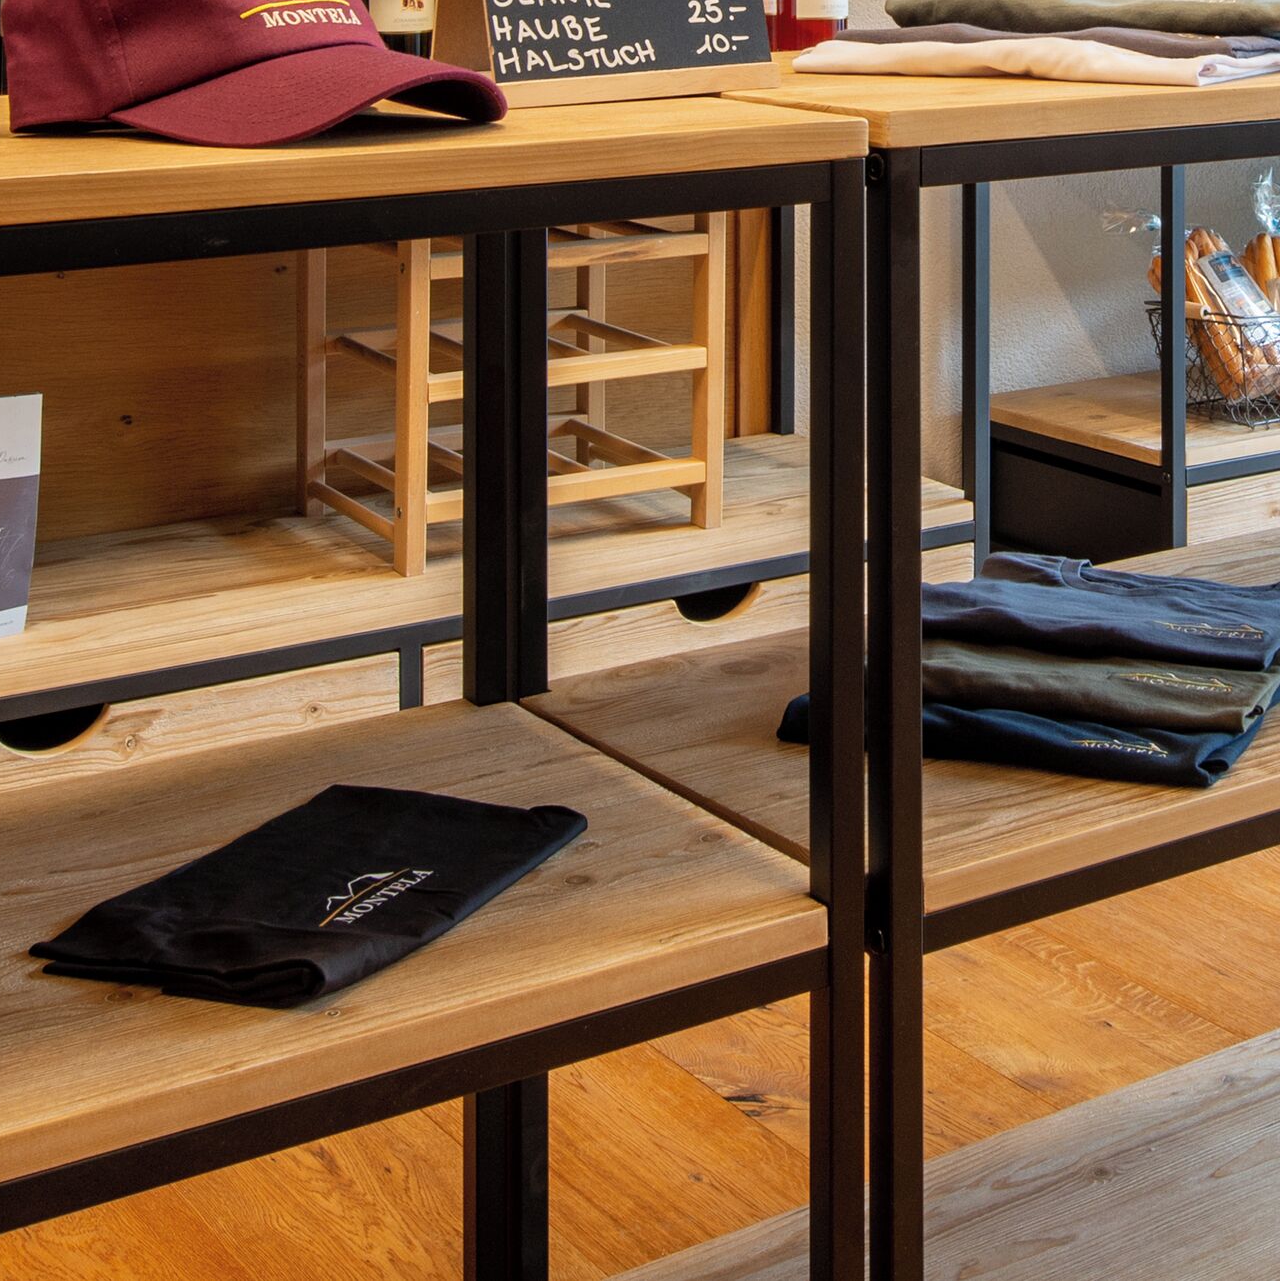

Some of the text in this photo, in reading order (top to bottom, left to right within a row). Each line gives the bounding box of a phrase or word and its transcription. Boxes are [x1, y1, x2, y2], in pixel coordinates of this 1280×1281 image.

[260, 7, 362, 29] MONTELA
[491, 14, 608, 44] HAUBE
[497, 38, 657, 75] HALSTUCH
[333, 869, 434, 924] MONTELA
